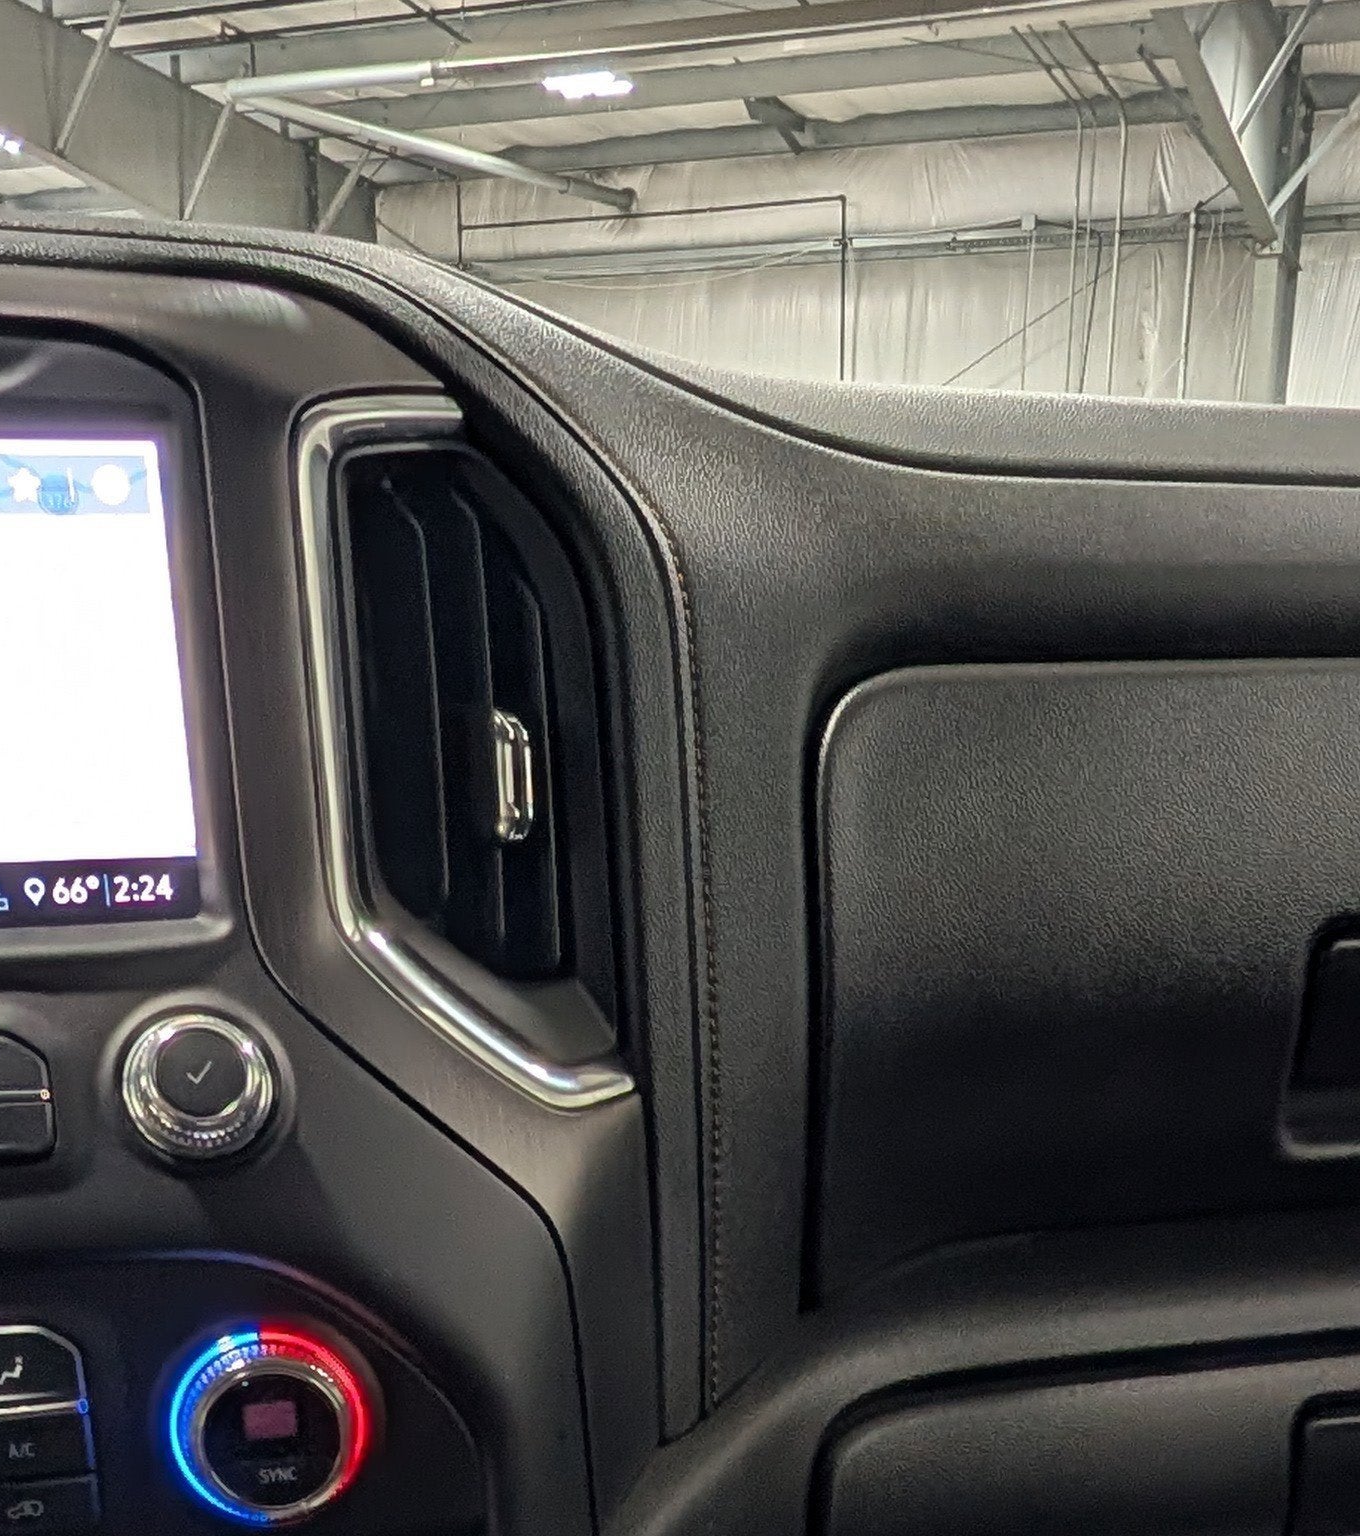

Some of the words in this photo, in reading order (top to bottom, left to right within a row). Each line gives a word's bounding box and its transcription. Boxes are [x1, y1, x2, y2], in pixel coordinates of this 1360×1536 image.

[52, 875, 100, 904] 66°
[114, 874, 174, 903] 2:24
[257, 1466, 298, 1484] SYNC
